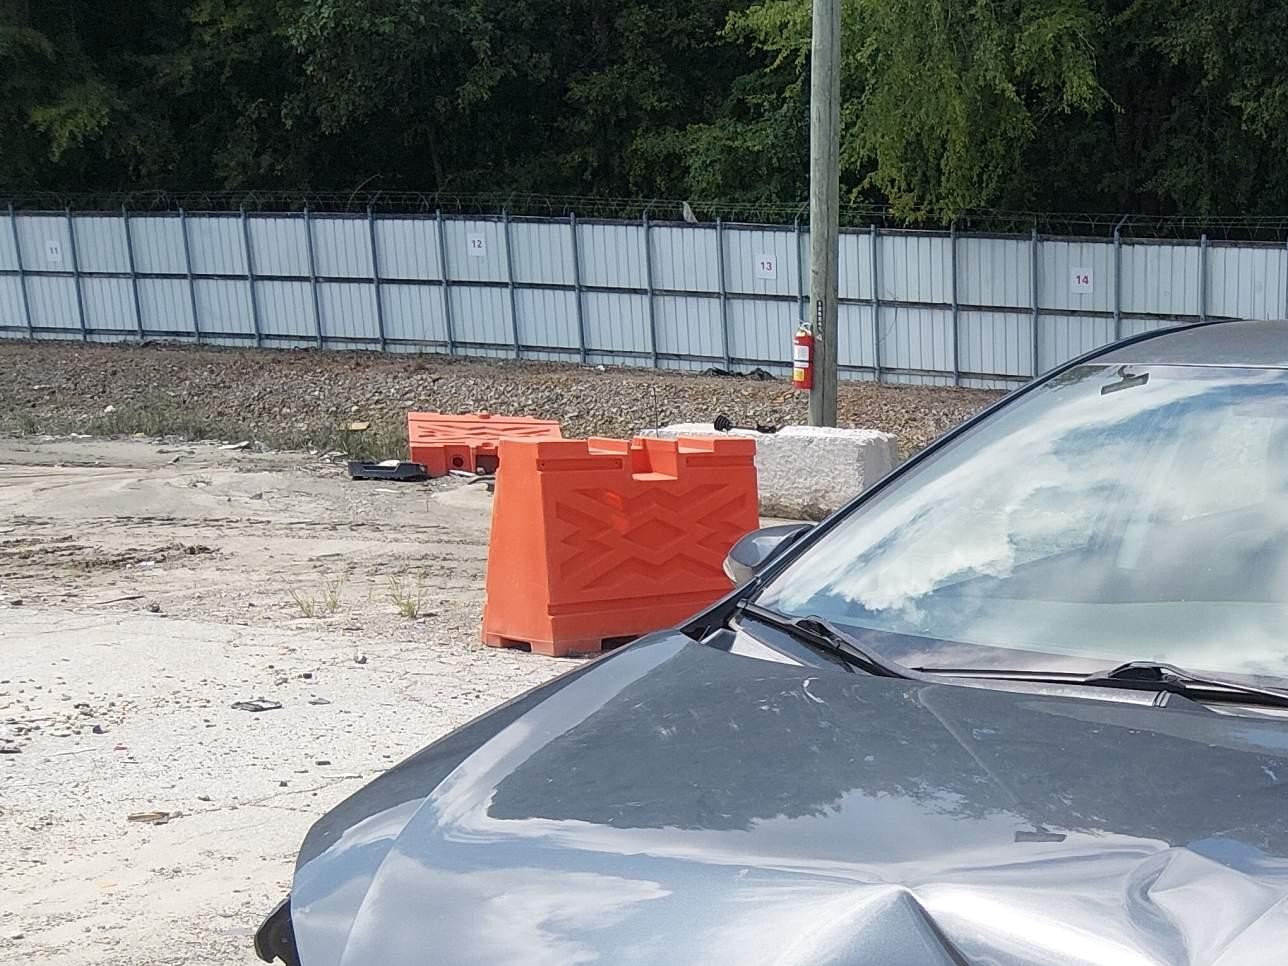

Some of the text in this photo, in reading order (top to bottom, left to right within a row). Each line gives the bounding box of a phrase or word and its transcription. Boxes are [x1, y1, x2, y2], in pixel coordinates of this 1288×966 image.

[471, 239, 482, 248] 12
[760, 261, 773, 271] 13
[1075, 275, 1089, 285] 14
